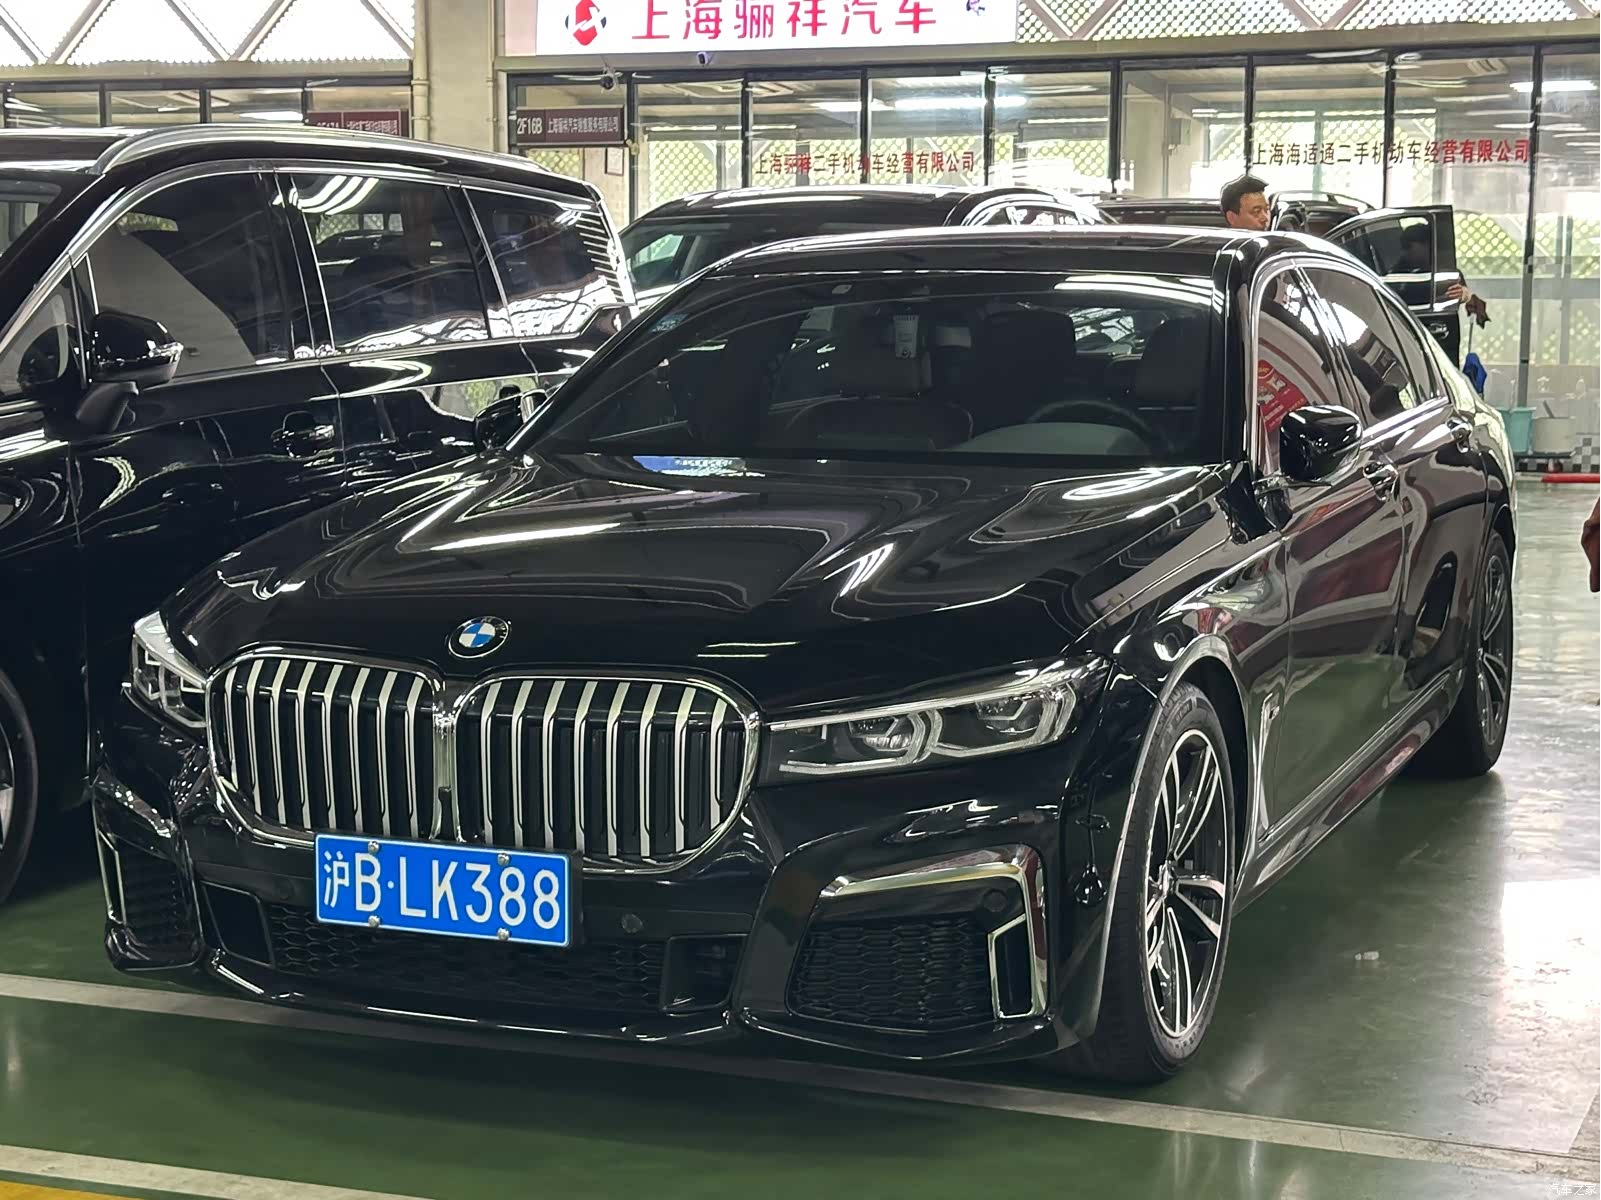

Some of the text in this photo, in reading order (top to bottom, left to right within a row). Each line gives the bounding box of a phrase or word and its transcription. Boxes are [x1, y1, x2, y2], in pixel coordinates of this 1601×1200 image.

[631, 0, 937, 40] 上海骊祥汽车
[516, 117, 543, 134] 2F16B
